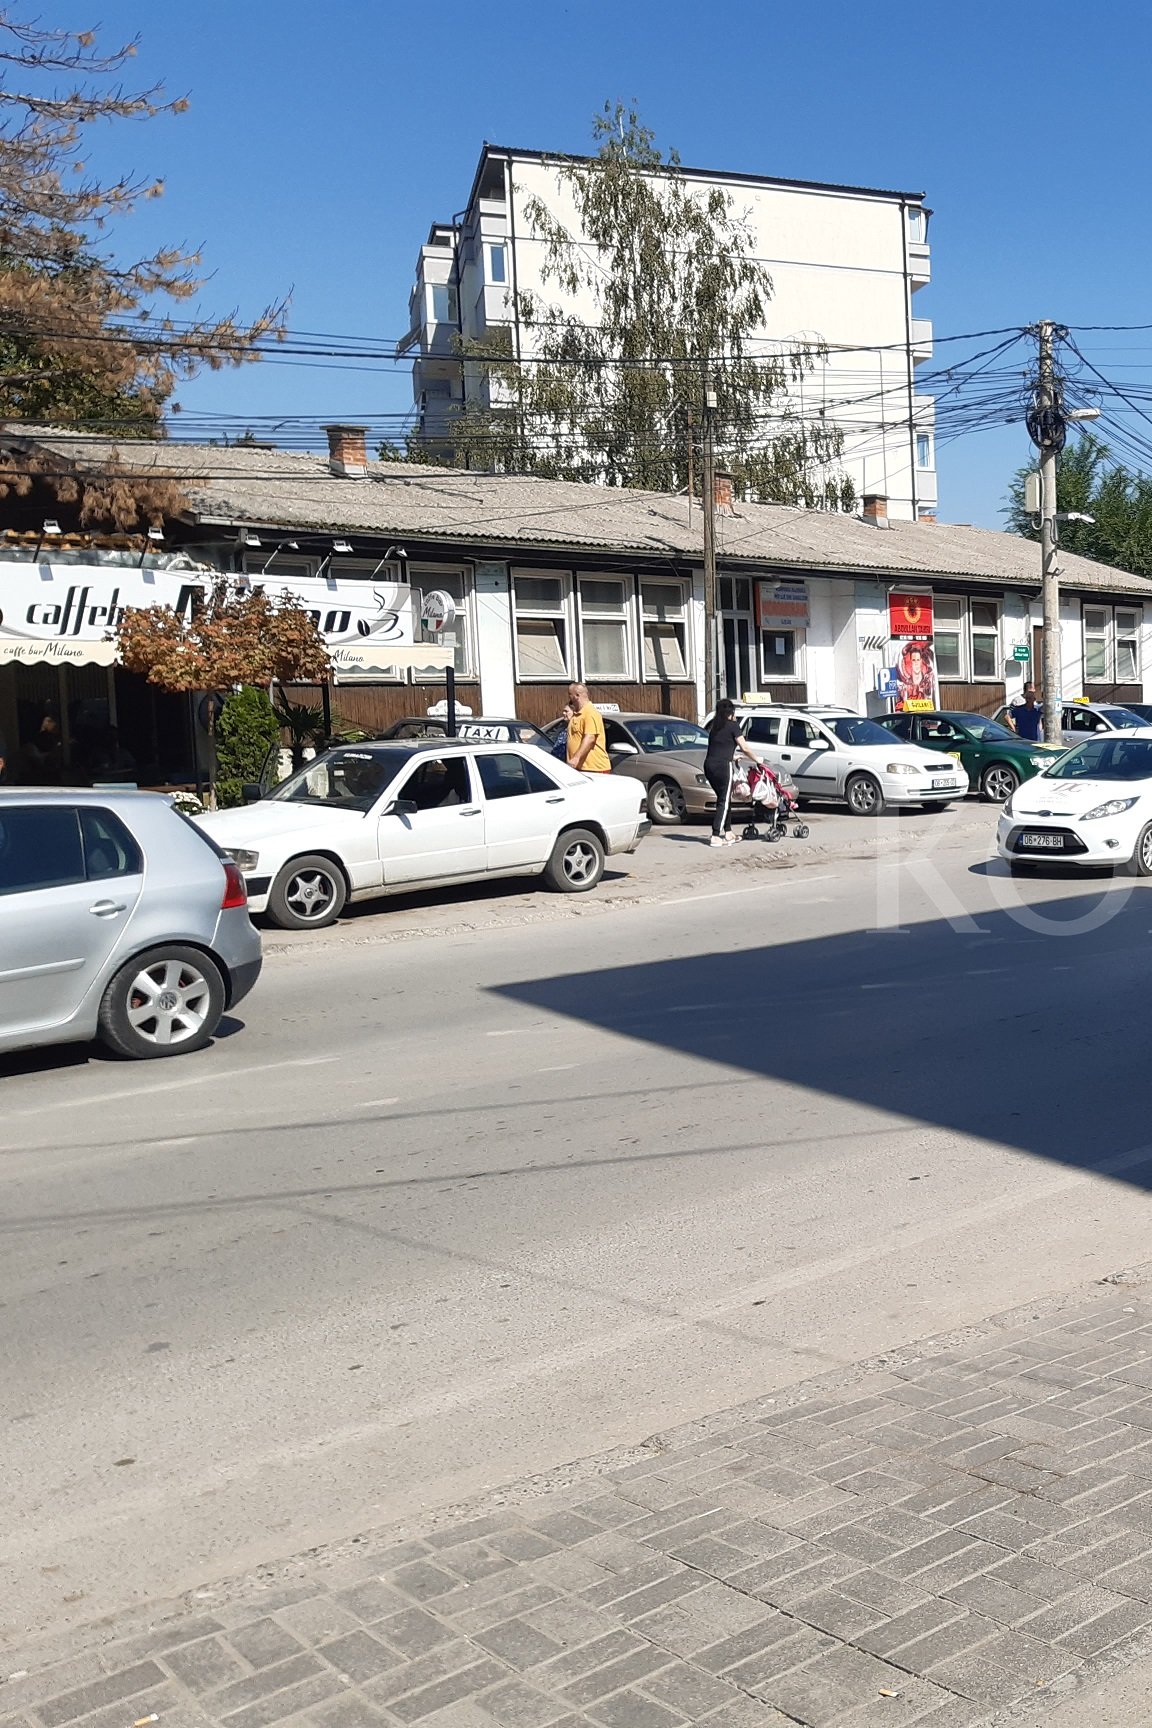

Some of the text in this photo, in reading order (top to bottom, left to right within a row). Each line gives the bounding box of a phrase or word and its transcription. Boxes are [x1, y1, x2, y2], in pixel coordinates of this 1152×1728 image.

[26, 585, 134, 636] caffeb
[3, 642, 84, 657] caffe bar Milano
[333, 649, 365, 663] Milano
[880, 668, 891, 691] P
[463, 725, 501, 740] TAXI
